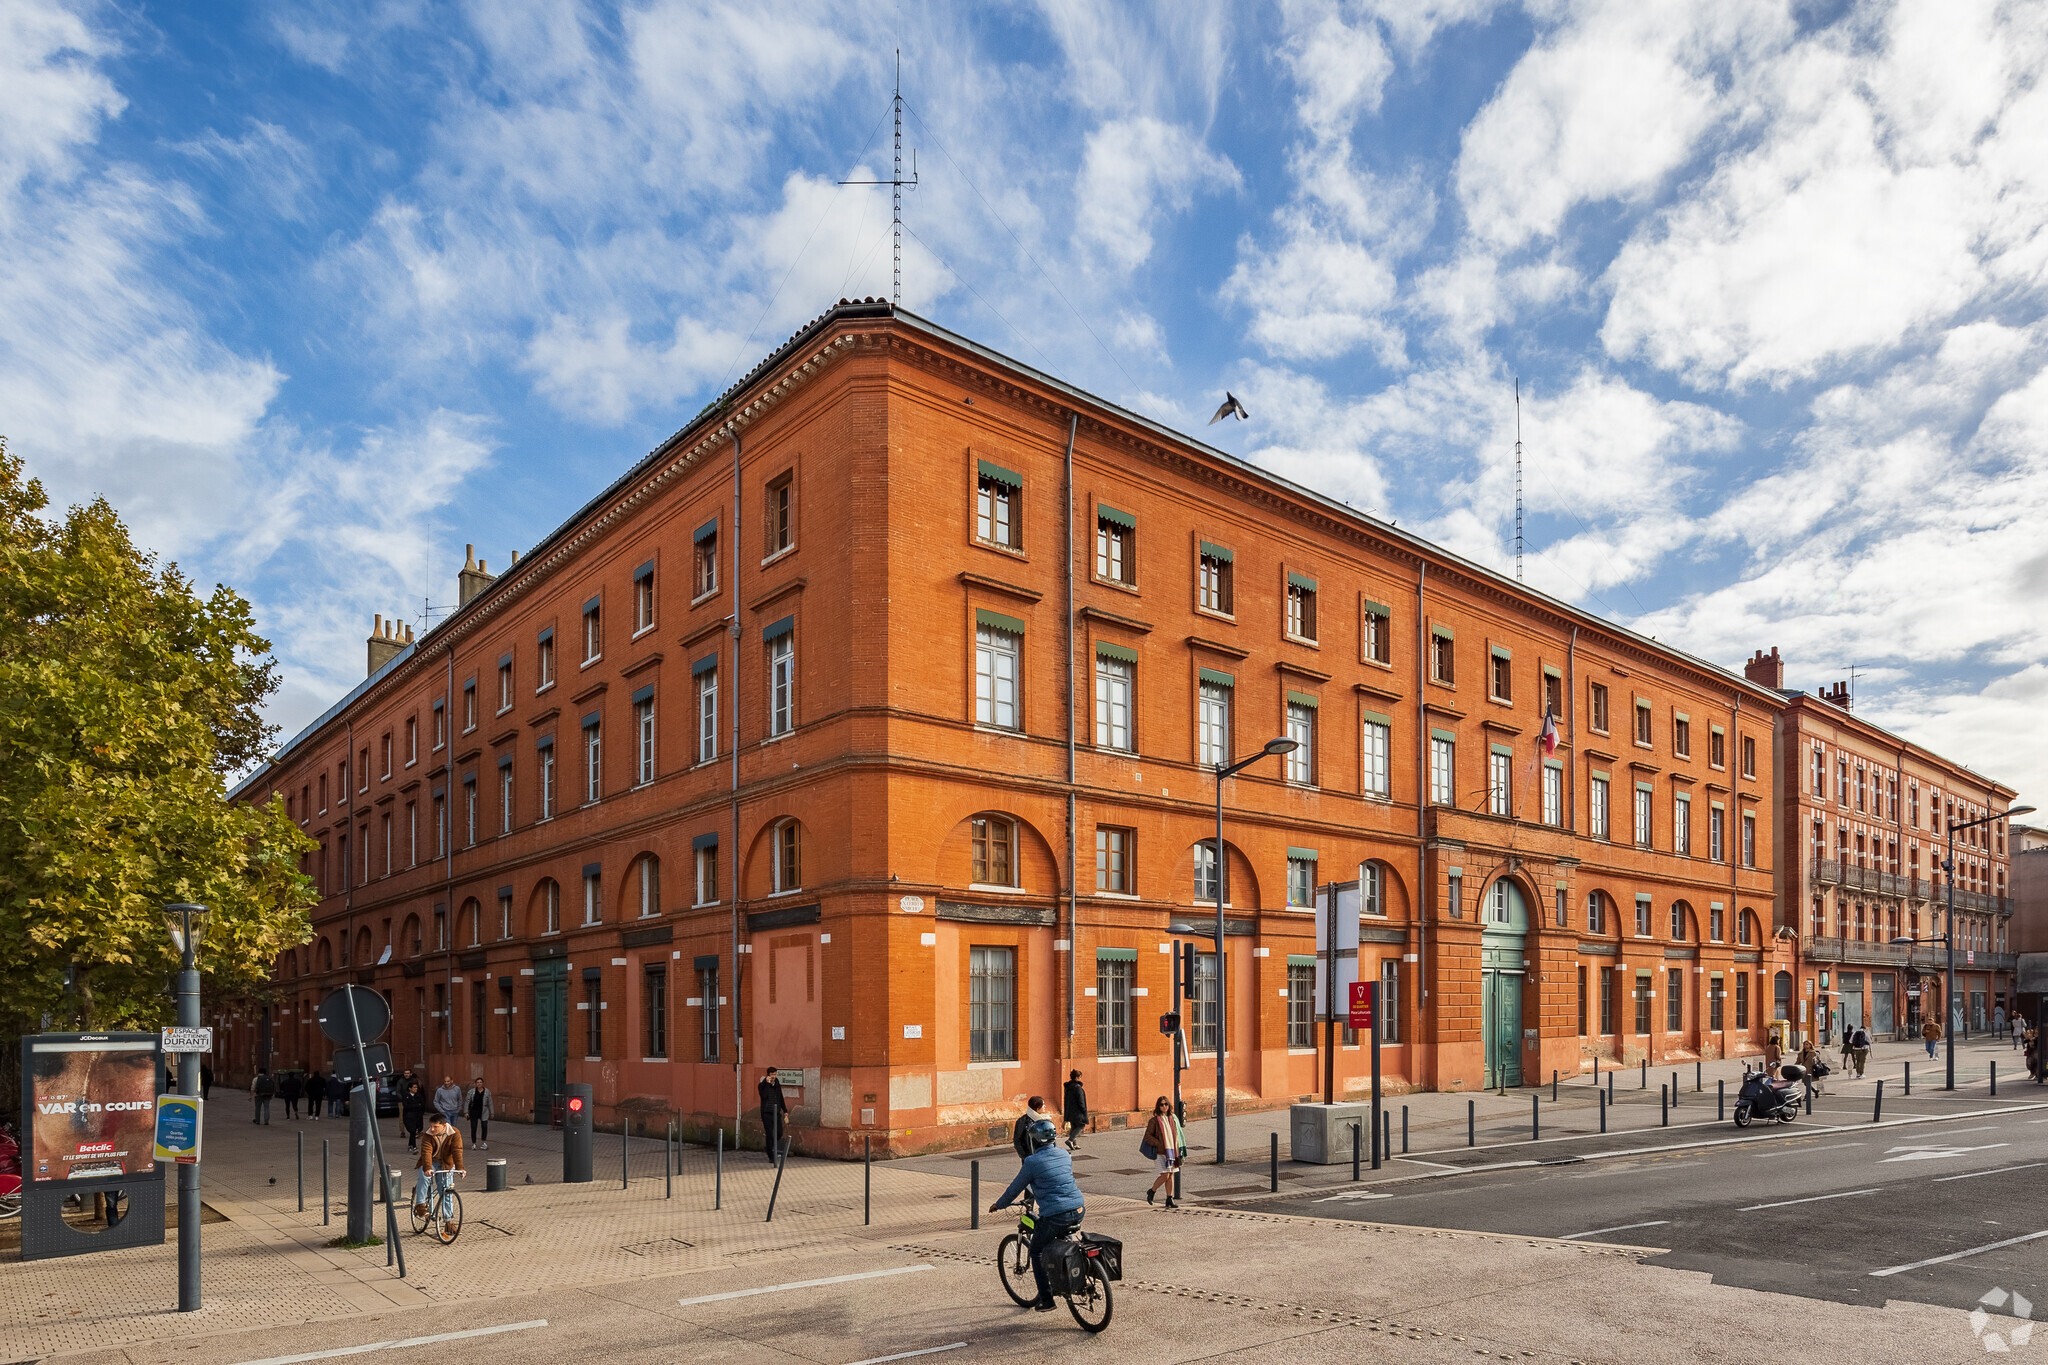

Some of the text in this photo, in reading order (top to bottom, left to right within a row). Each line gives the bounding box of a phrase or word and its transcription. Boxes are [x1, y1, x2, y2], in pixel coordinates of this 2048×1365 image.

[38, 1101, 152, 1114] VAR en cours
[80, 1143, 112, 1152] Betclic
